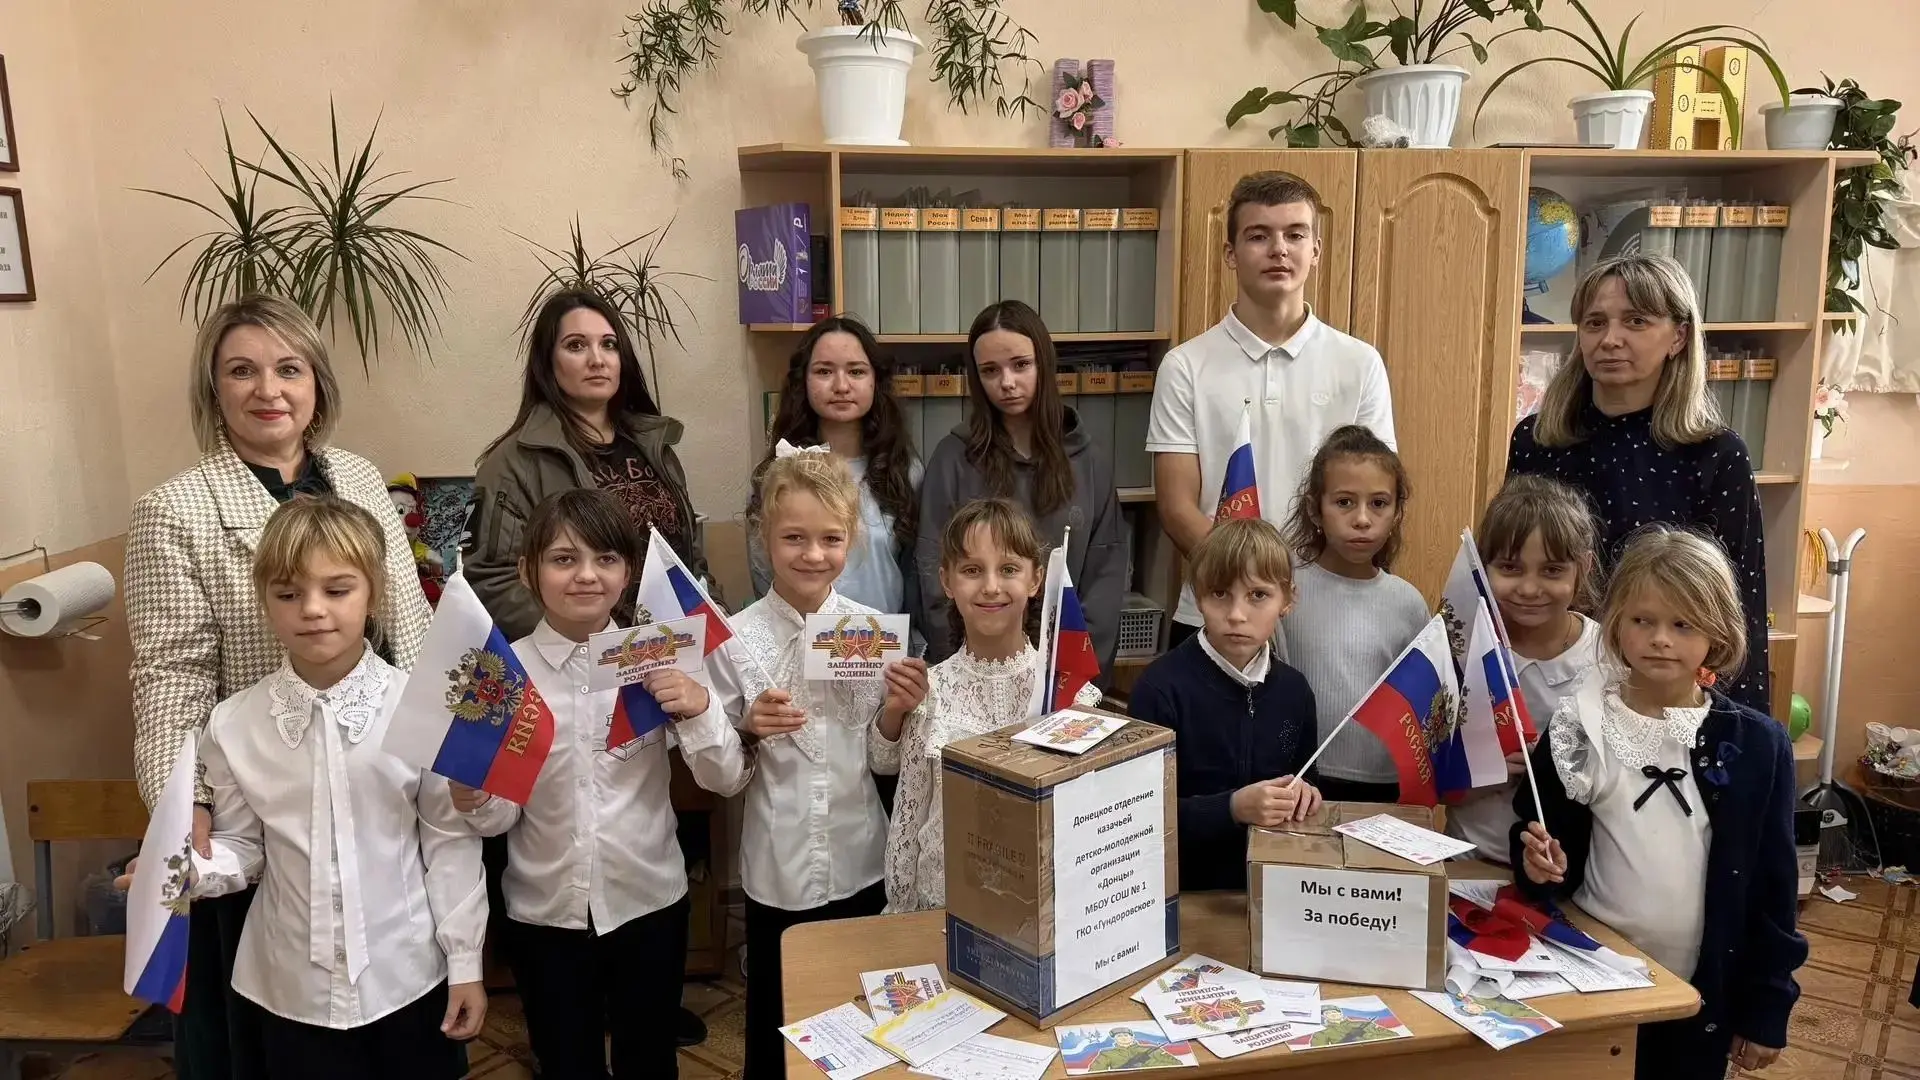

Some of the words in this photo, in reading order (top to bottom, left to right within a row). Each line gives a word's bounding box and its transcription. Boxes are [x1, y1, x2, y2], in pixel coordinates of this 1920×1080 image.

[970, 214, 993, 223] Семья
[615, 657, 678, 677] ЗАЩИТНИКУ
[827, 661, 885, 669] ЗАЩИТНИКУ
[834, 670, 876, 678] РОДИНЫ!
[1398, 711, 1433, 785] РОССИЯ
[1072, 804, 1113, 828] Донецкое
[1114, 789, 1154, 810] отделение
[1097, 813, 1133, 835] казачьей
[1075, 824, 1154, 866] детско-молодежной
[1090, 849, 1141, 875] организации
[1097, 869, 1134, 890] «Донцы»
[1085, 897, 1109, 915] МБОУ
[1111, 888, 1130, 904] СОШ
[1131, 884, 1140, 896] №
[1142, 881, 1147, 890] 1
[1300, 880, 1332, 896] Мы
[1337, 886, 1346, 897] с
[1350, 887, 1402, 902] вами!
[1076, 925, 1092, 939] ГКО
[1093, 898, 1156, 930] «Гундоровское»
[1303, 909, 1323, 923] За
[1328, 912, 1397, 931] победу!
[1095, 958, 1110, 970] Мы
[1116, 941, 1140, 960] вами!
[1174, 989, 1238, 1005] ЗАЩИТНИКУ
[1233, 1023, 1293, 1045] ЗАЩИТНИКУ
